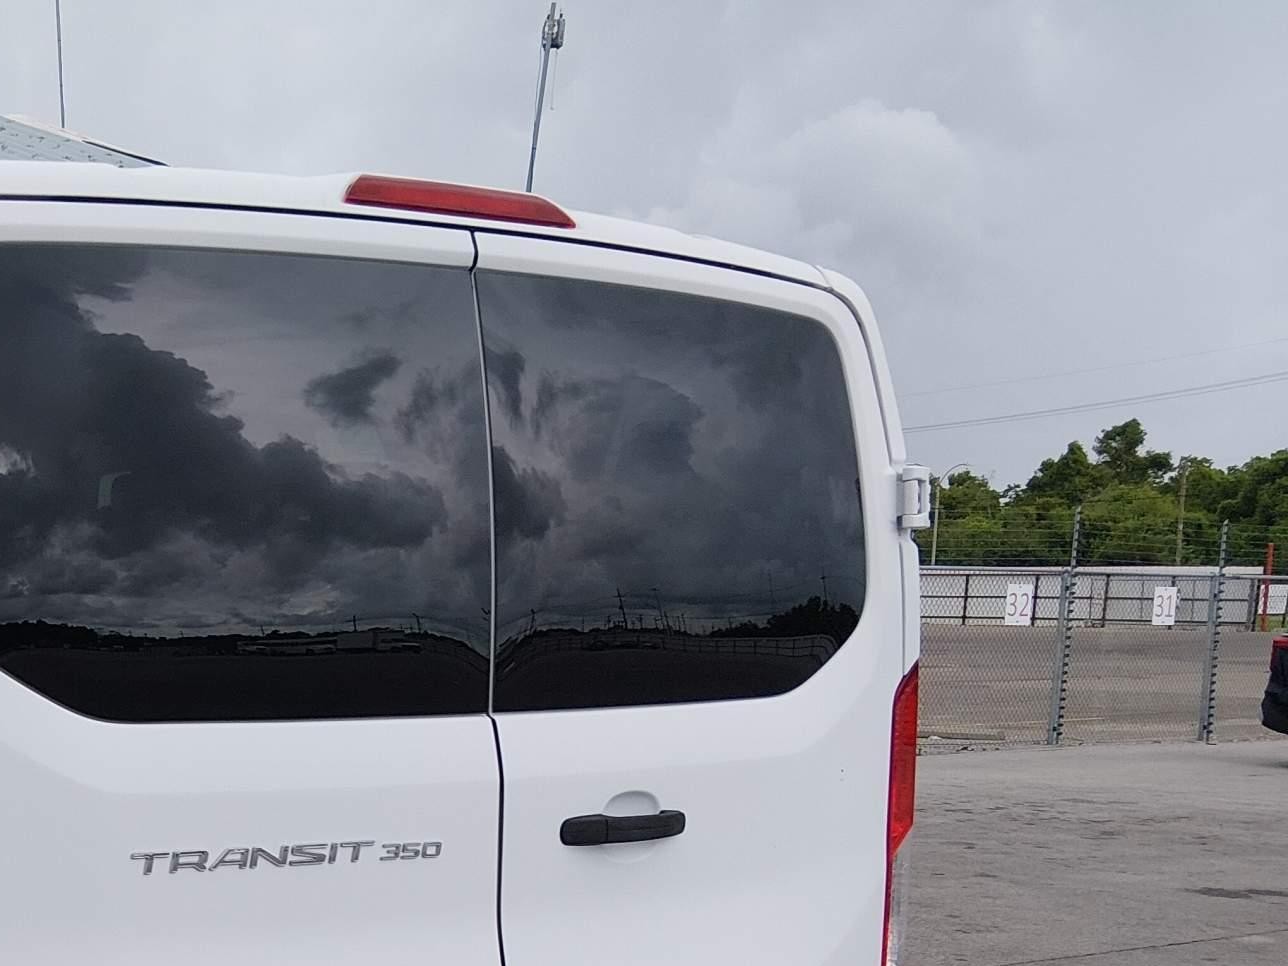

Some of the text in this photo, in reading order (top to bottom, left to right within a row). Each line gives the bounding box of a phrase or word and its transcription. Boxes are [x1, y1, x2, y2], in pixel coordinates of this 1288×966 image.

[1007, 593, 1031, 618] 32
[1155, 595, 1175, 619] 31
[130, 839, 442, 876] TRANSIT 350
